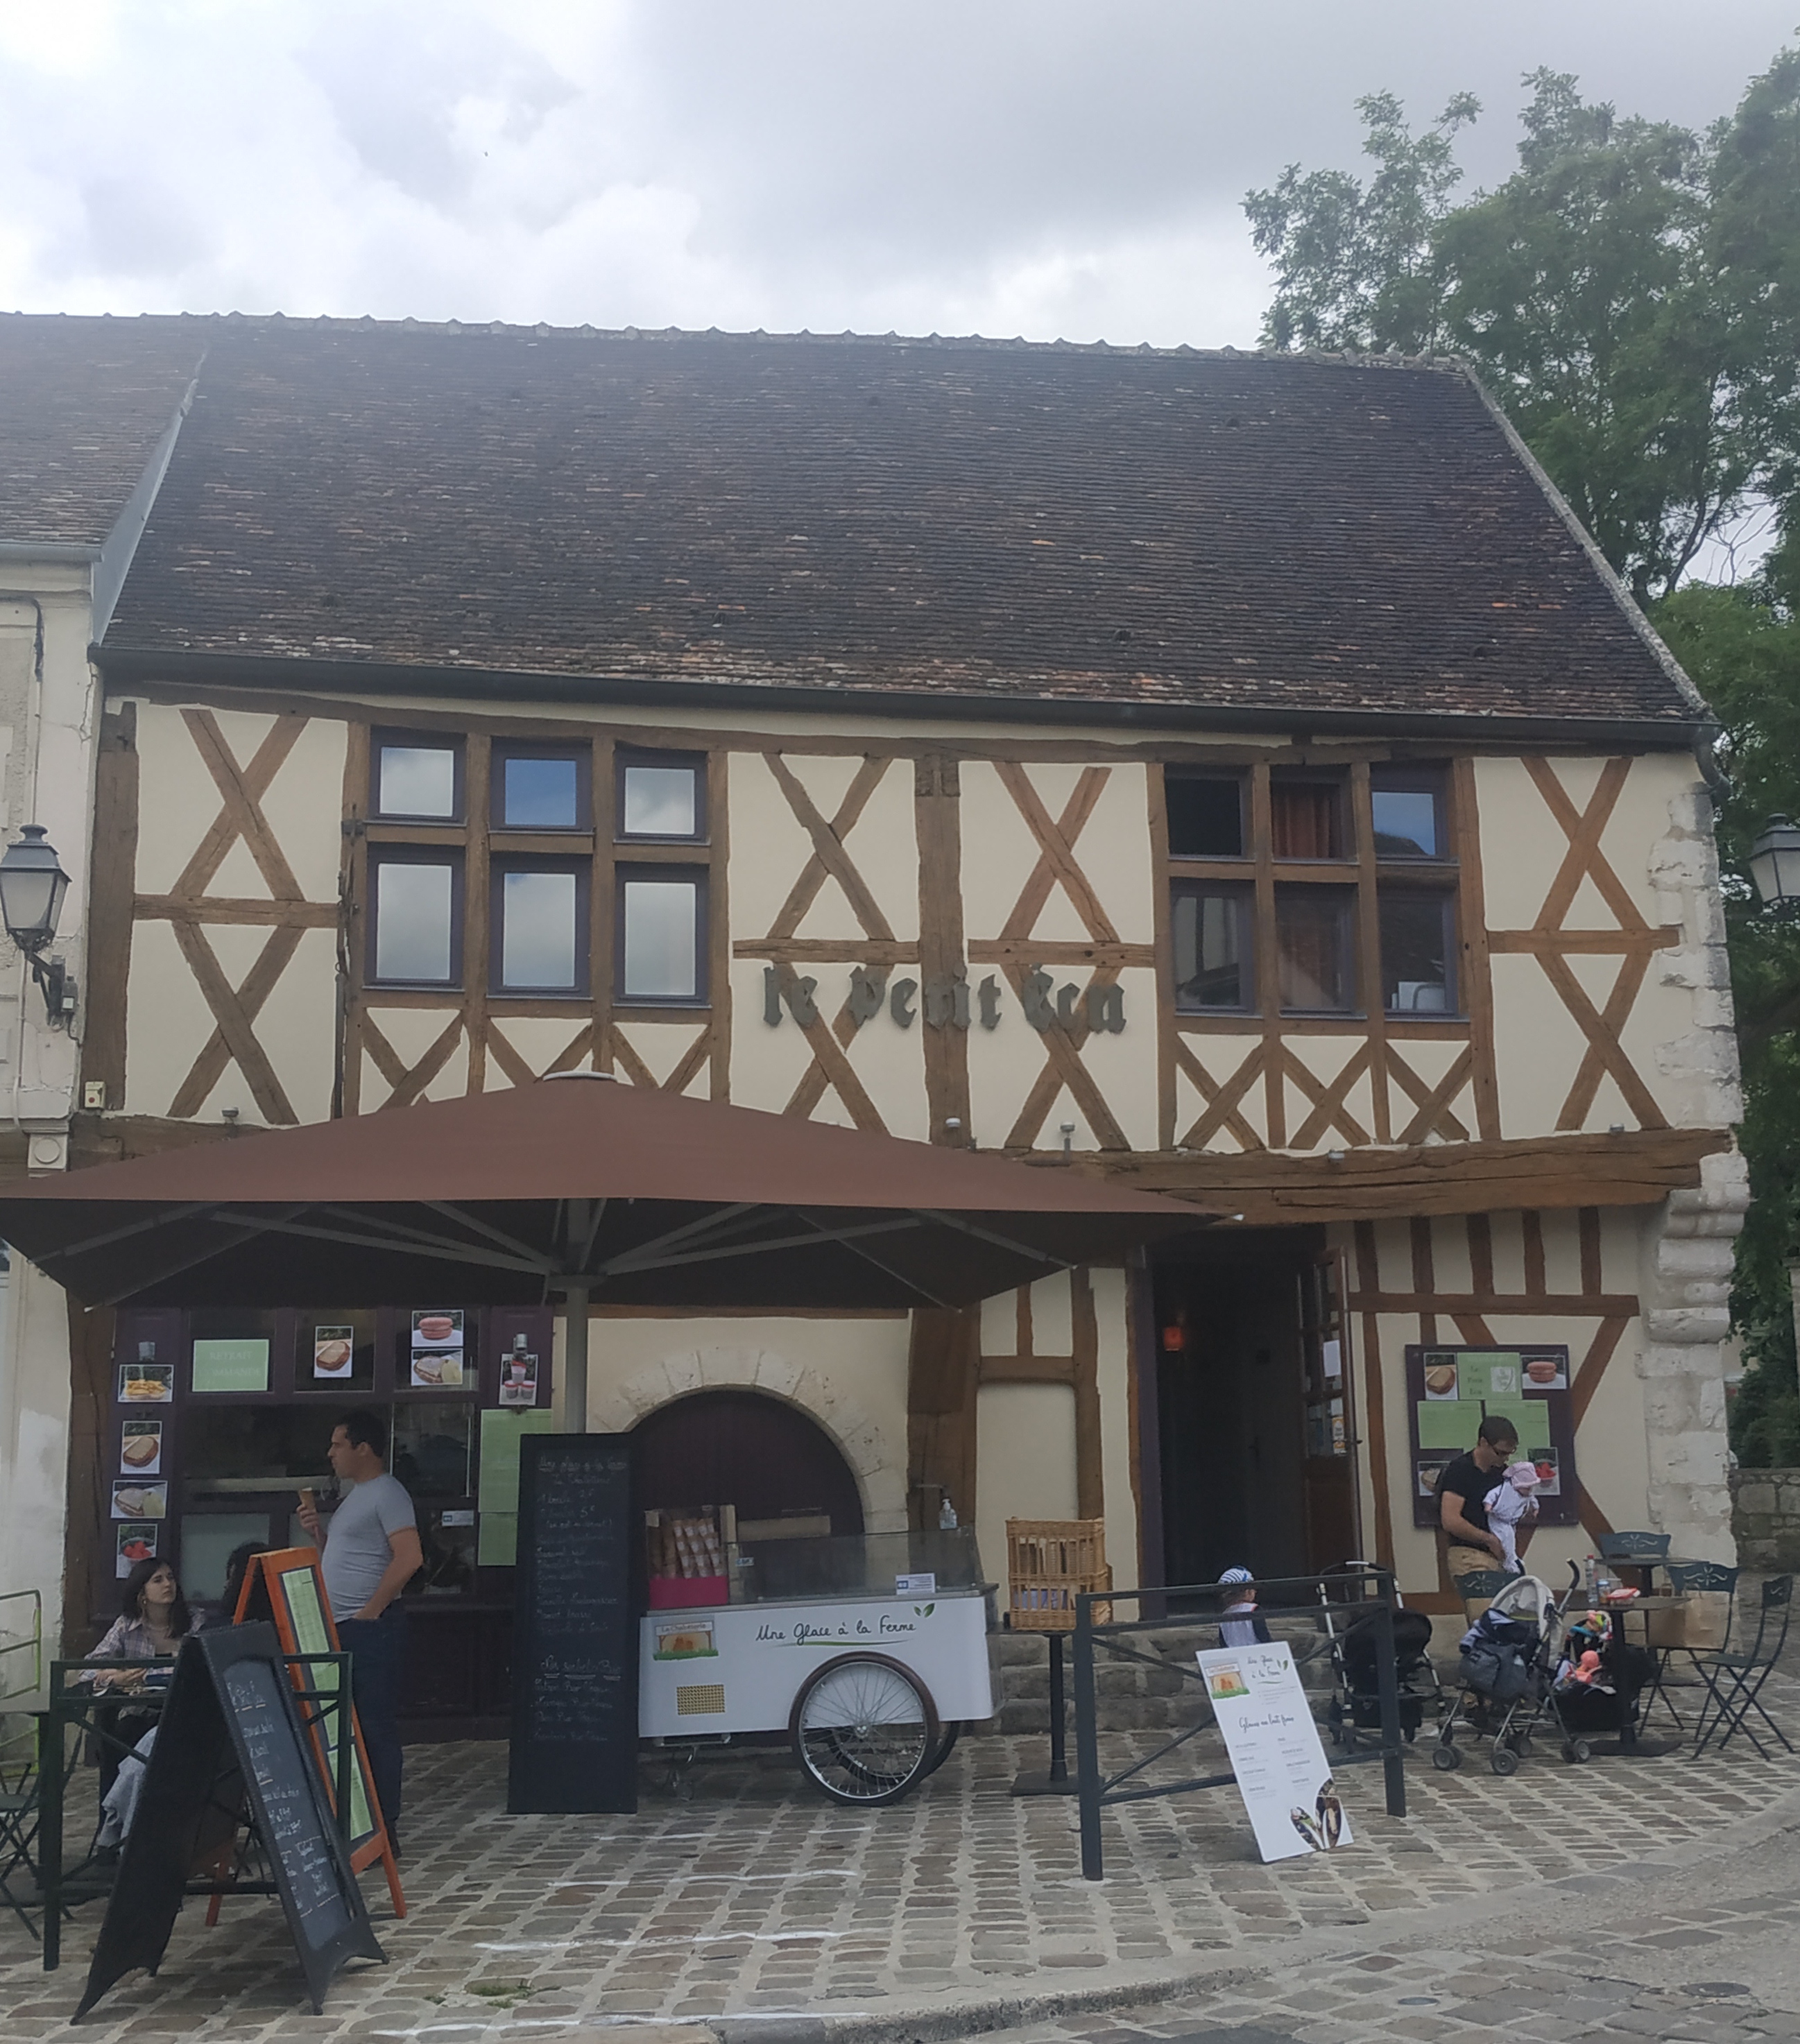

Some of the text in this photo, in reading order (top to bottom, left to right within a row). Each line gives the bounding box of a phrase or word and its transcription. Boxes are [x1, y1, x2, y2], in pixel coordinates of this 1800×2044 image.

[848, 962, 1002, 1031] petit
[755, 1624, 786, 1642] Une
[794, 1622, 832, 1646] Glace
[837, 1622, 849, 1635] à
[856, 1620, 871, 1635] la
